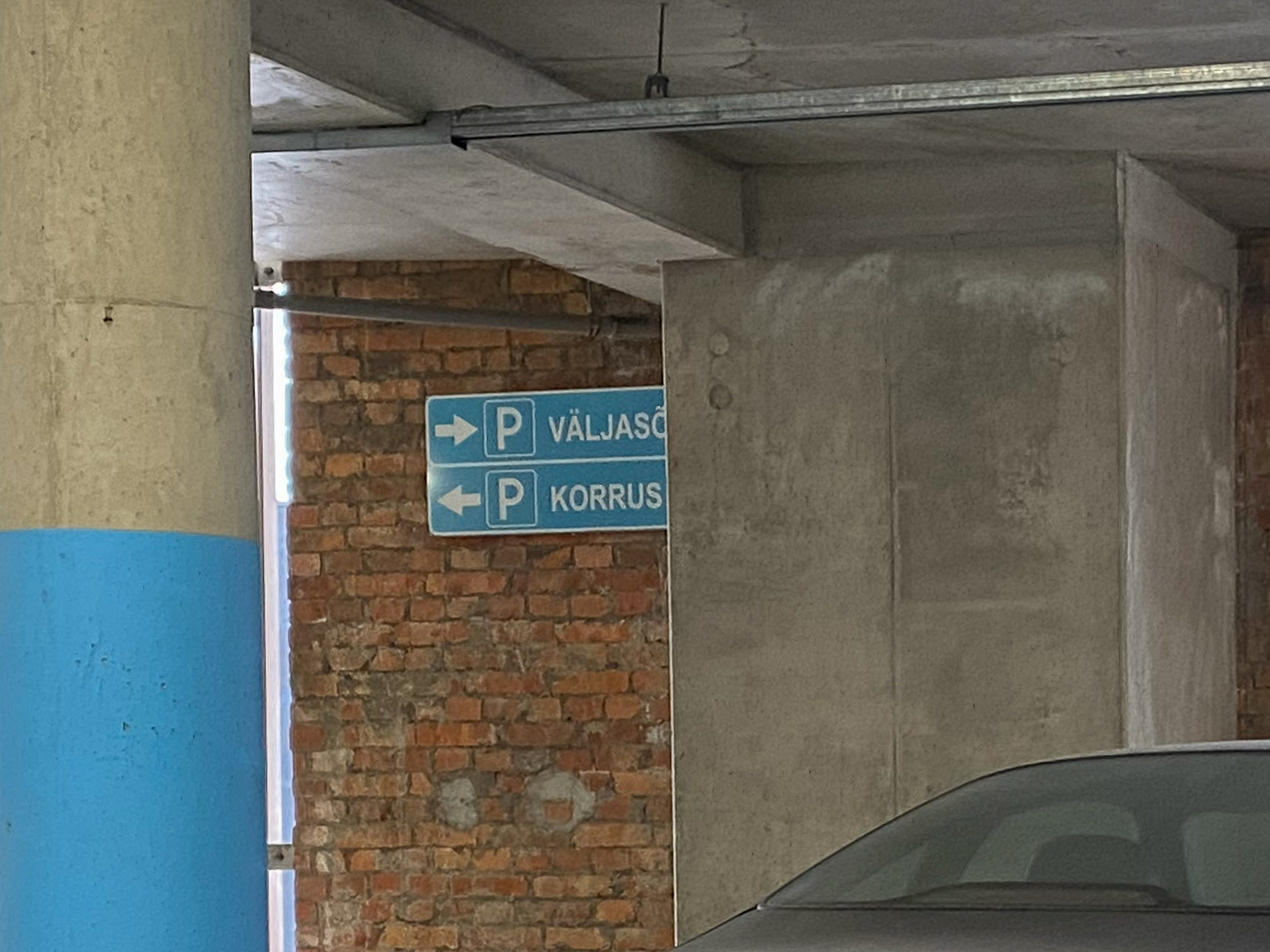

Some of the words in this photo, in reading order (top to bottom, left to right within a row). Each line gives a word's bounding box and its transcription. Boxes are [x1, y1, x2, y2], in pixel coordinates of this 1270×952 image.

[496, 406, 523, 451] P
[497, 477, 525, 521] P
[550, 482, 662, 512] KORRUS
